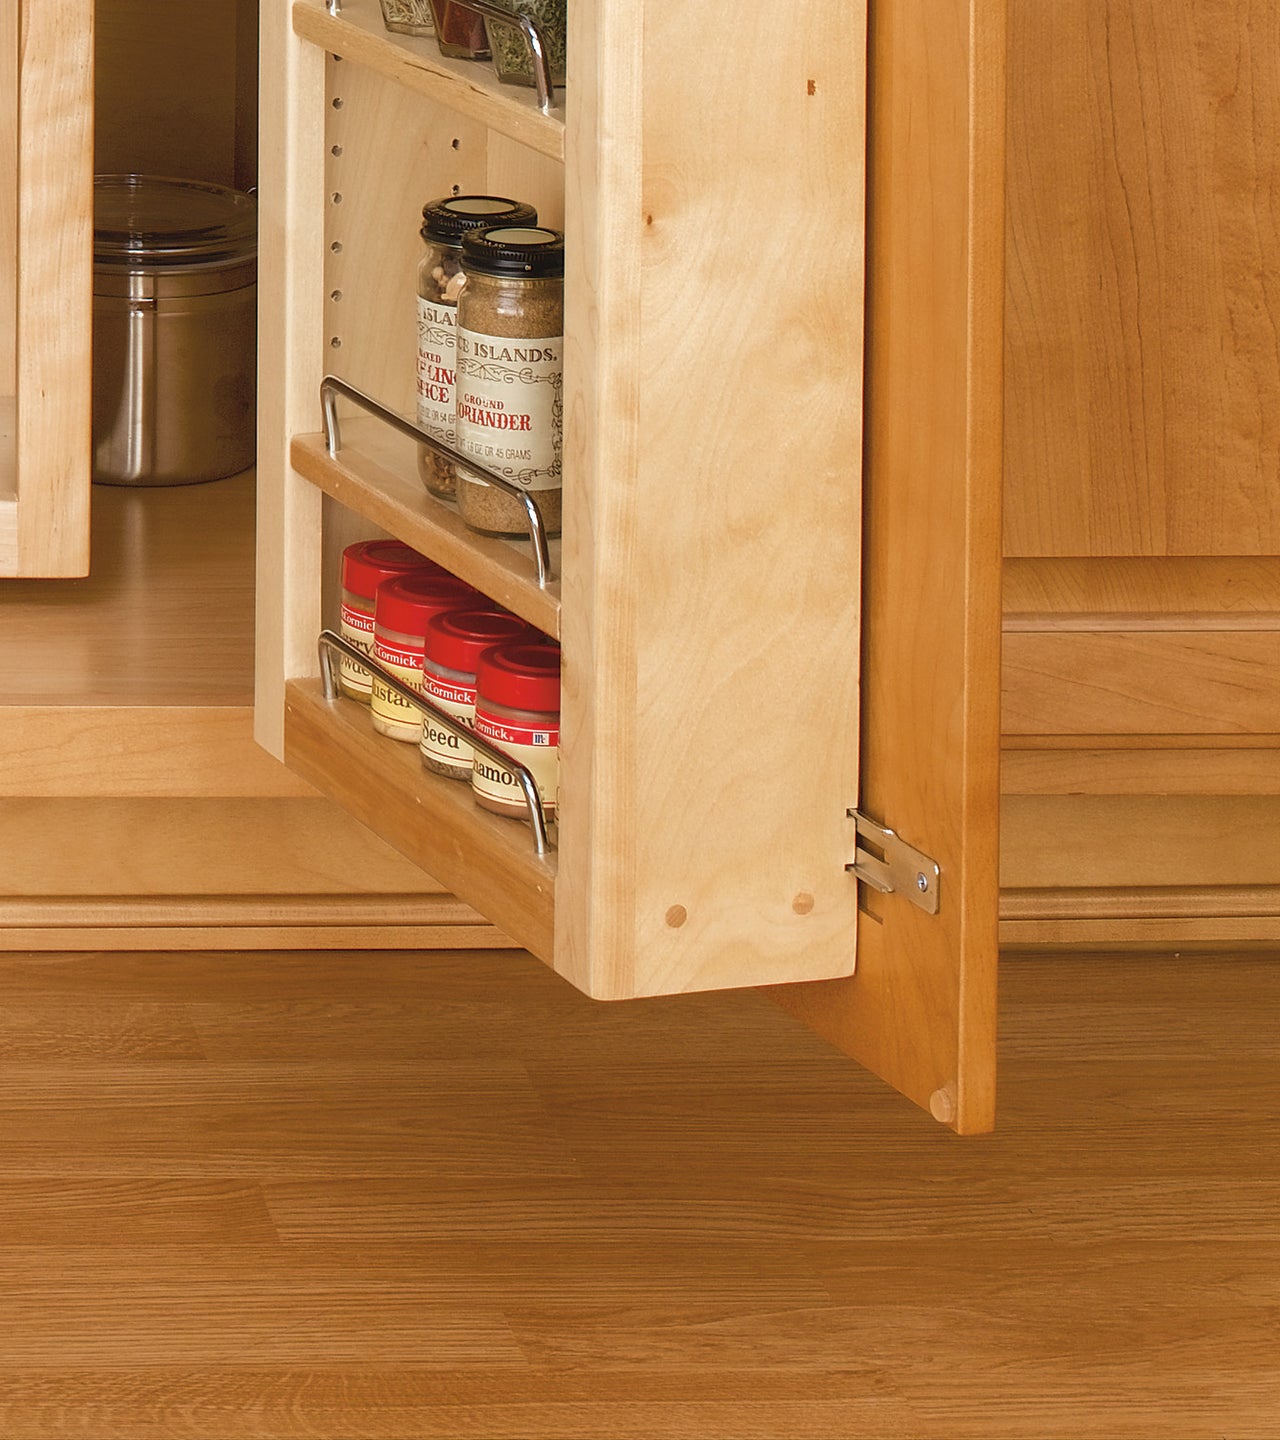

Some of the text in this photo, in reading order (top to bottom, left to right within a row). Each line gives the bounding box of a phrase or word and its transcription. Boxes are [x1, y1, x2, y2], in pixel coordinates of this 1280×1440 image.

[464, 393, 504, 410] GROUND
[458, 401, 532, 431] ORIANDER
[485, 445, 494, 457] OR
[496, 448, 504, 458] 45
[505, 448, 532, 460] GRAMS
